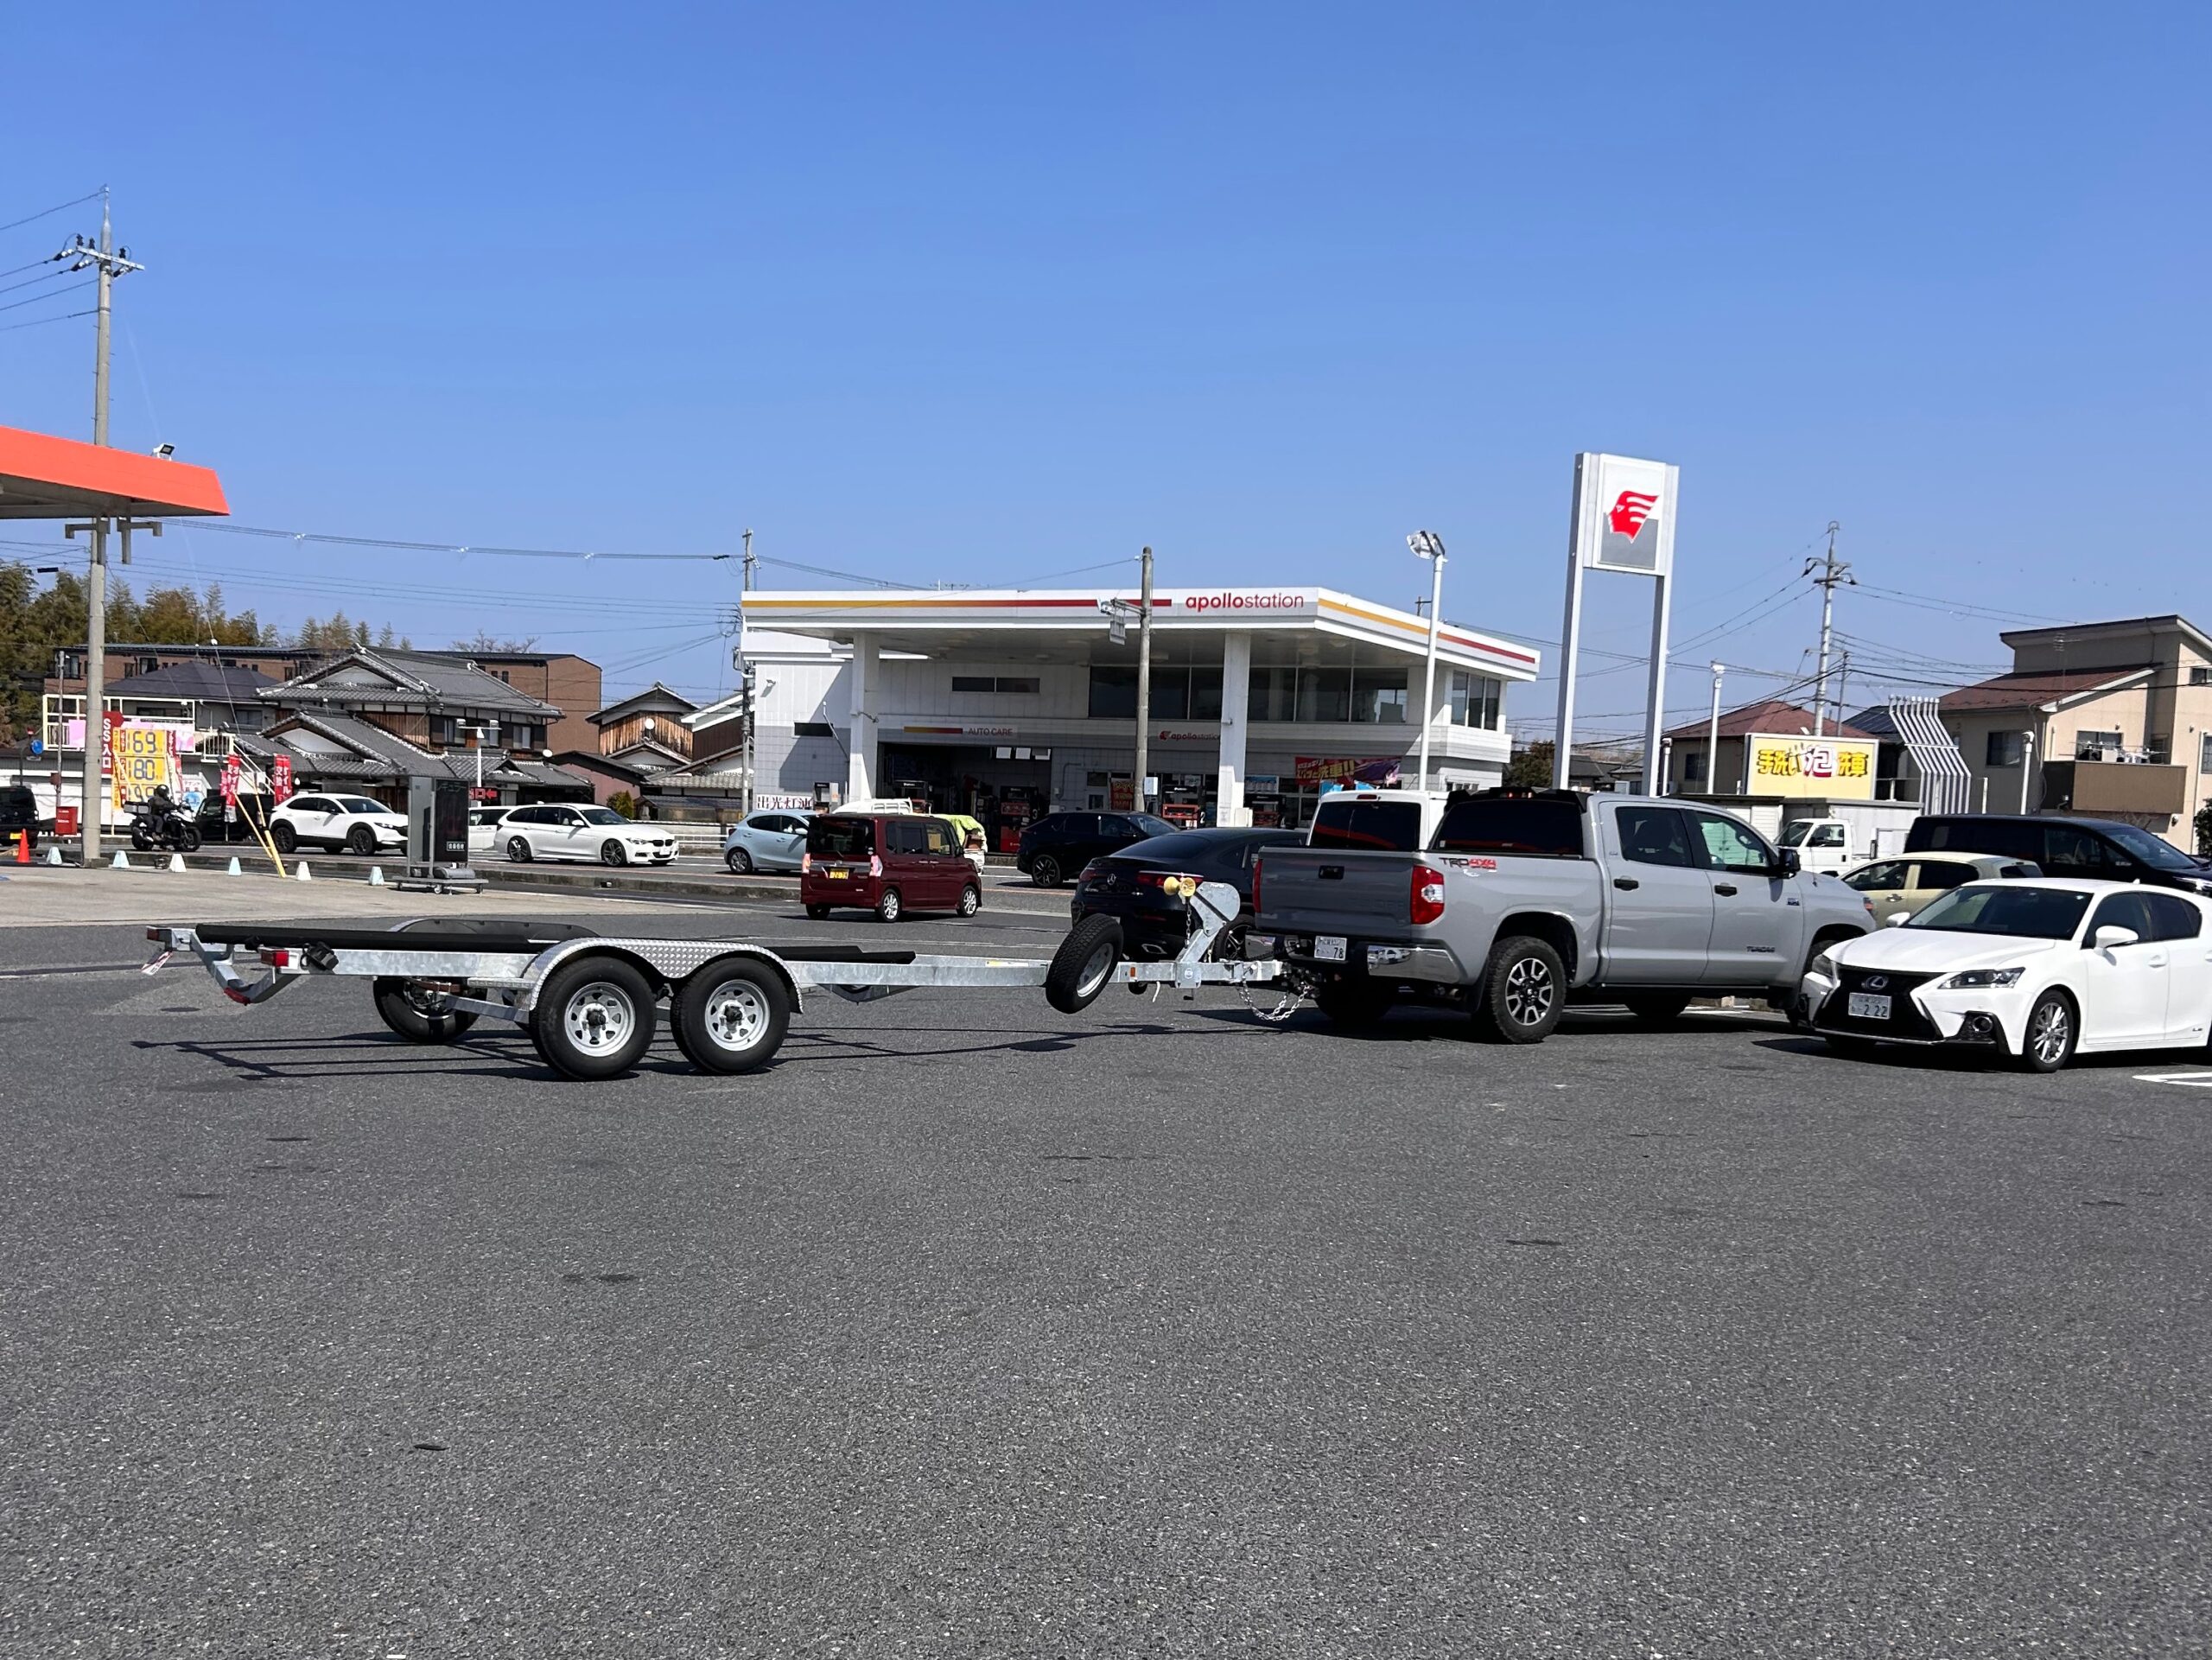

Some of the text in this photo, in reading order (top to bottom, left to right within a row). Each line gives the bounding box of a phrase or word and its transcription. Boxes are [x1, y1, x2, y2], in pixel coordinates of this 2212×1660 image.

[1185, 593, 1304, 612] apollostation
[103, 718, 111, 768] SS入口
[1333, 946, 1344, 959] 78
